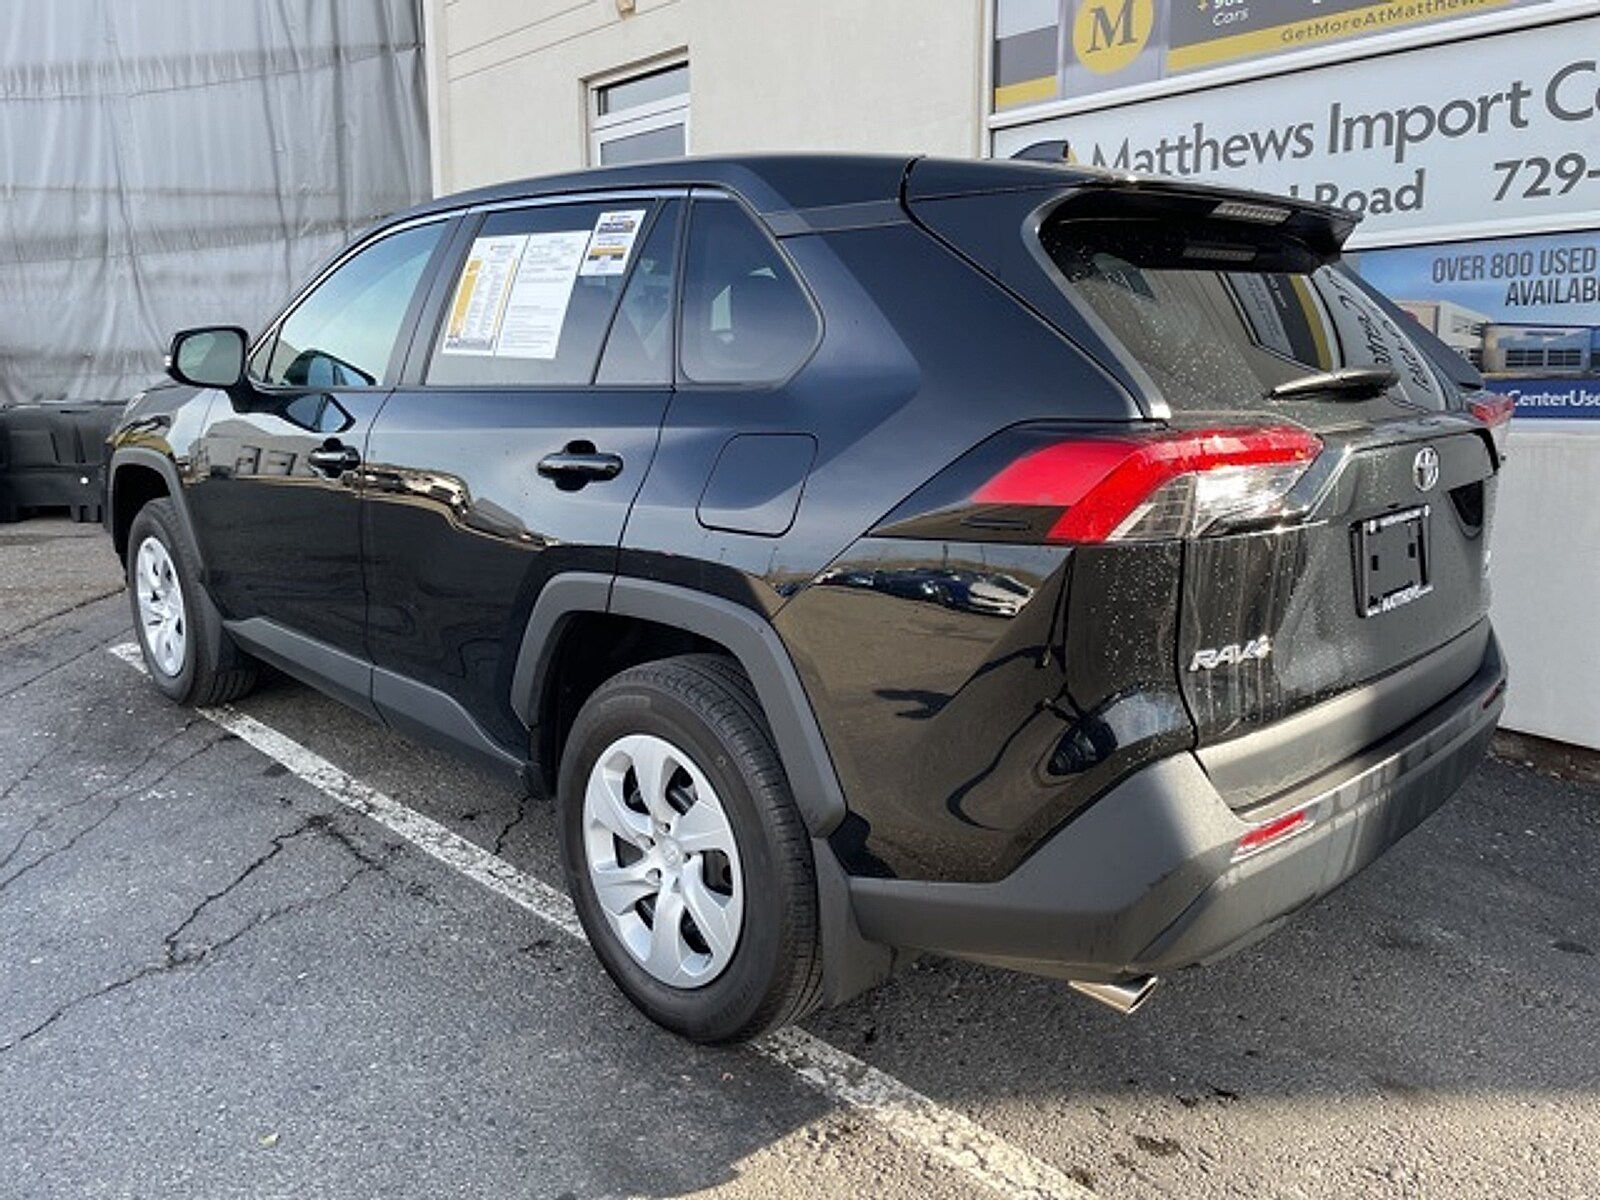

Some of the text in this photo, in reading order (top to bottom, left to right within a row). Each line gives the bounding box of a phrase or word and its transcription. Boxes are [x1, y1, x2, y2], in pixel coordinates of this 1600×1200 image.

[1085, 0, 1137, 53] M
[1212, 8, 1249, 26] Cars
[1091, 122, 1315, 177] Matthews
[1327, 80, 1532, 163] Import
[1315, 168, 1426, 214] Road
[1432, 246, 1597, 283] OVER 800 USED
[1505, 276, 1600, 306] AVAILAB
[1188, 634, 1272, 672] RAV4
